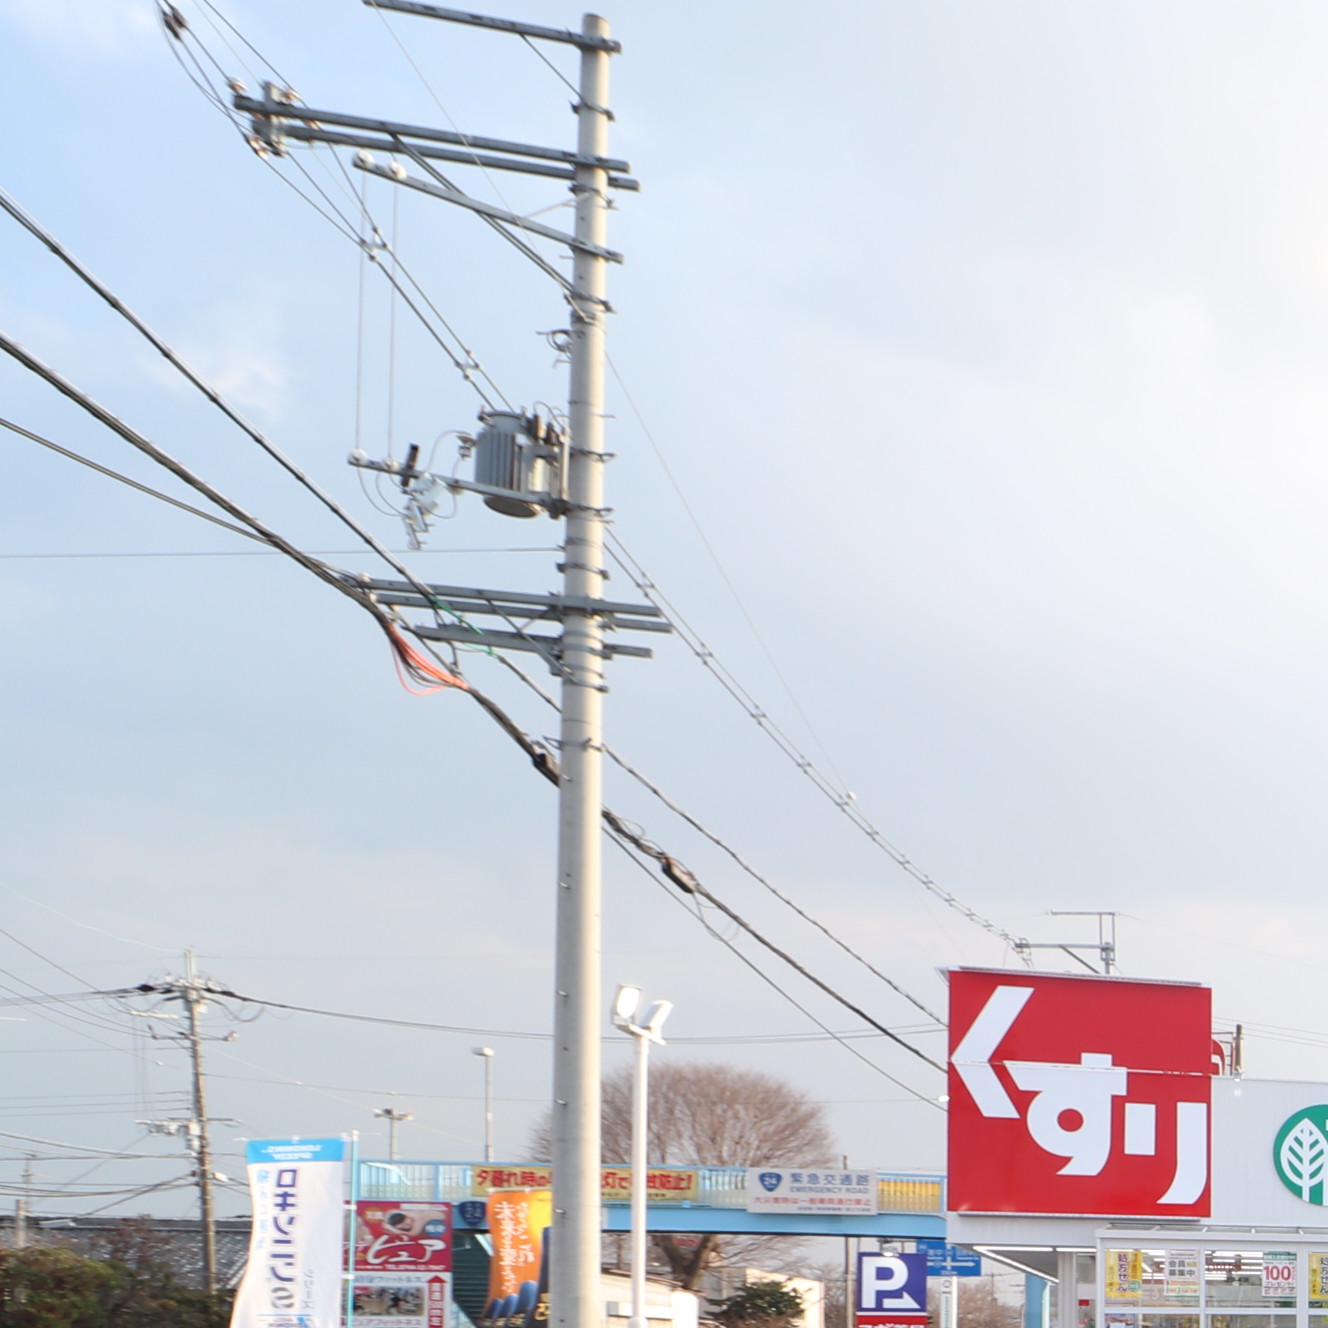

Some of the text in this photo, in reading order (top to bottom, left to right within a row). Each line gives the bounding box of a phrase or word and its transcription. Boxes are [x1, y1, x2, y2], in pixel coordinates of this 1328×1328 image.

[950, 985, 1207, 1205] くすり
[366, 1234, 447, 1265] ピュア
[861, 1256, 909, 1309] P
[1263, 1265, 1292, 1281] 100
